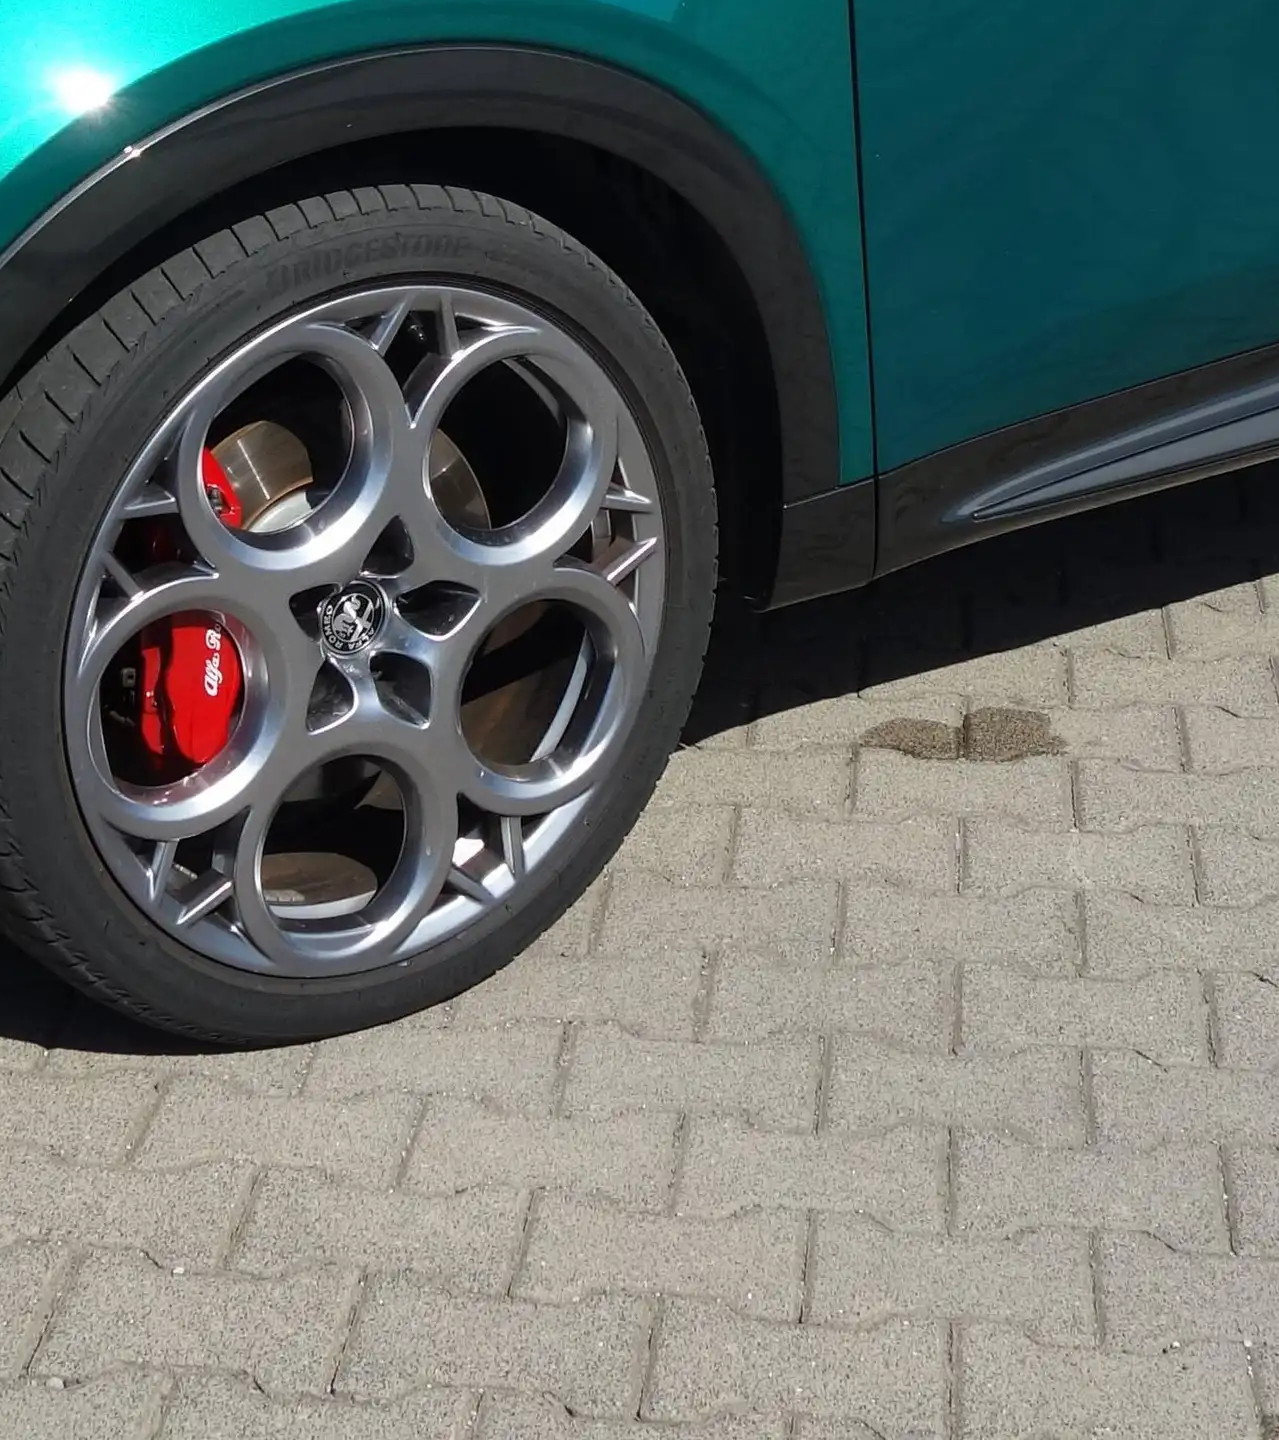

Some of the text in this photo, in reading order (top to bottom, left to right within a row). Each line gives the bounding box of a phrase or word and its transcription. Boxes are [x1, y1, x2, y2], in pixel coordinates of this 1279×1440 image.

[323, 605, 375, 651] ALFA ROMEO
[204, 652, 223, 697] Alfa
